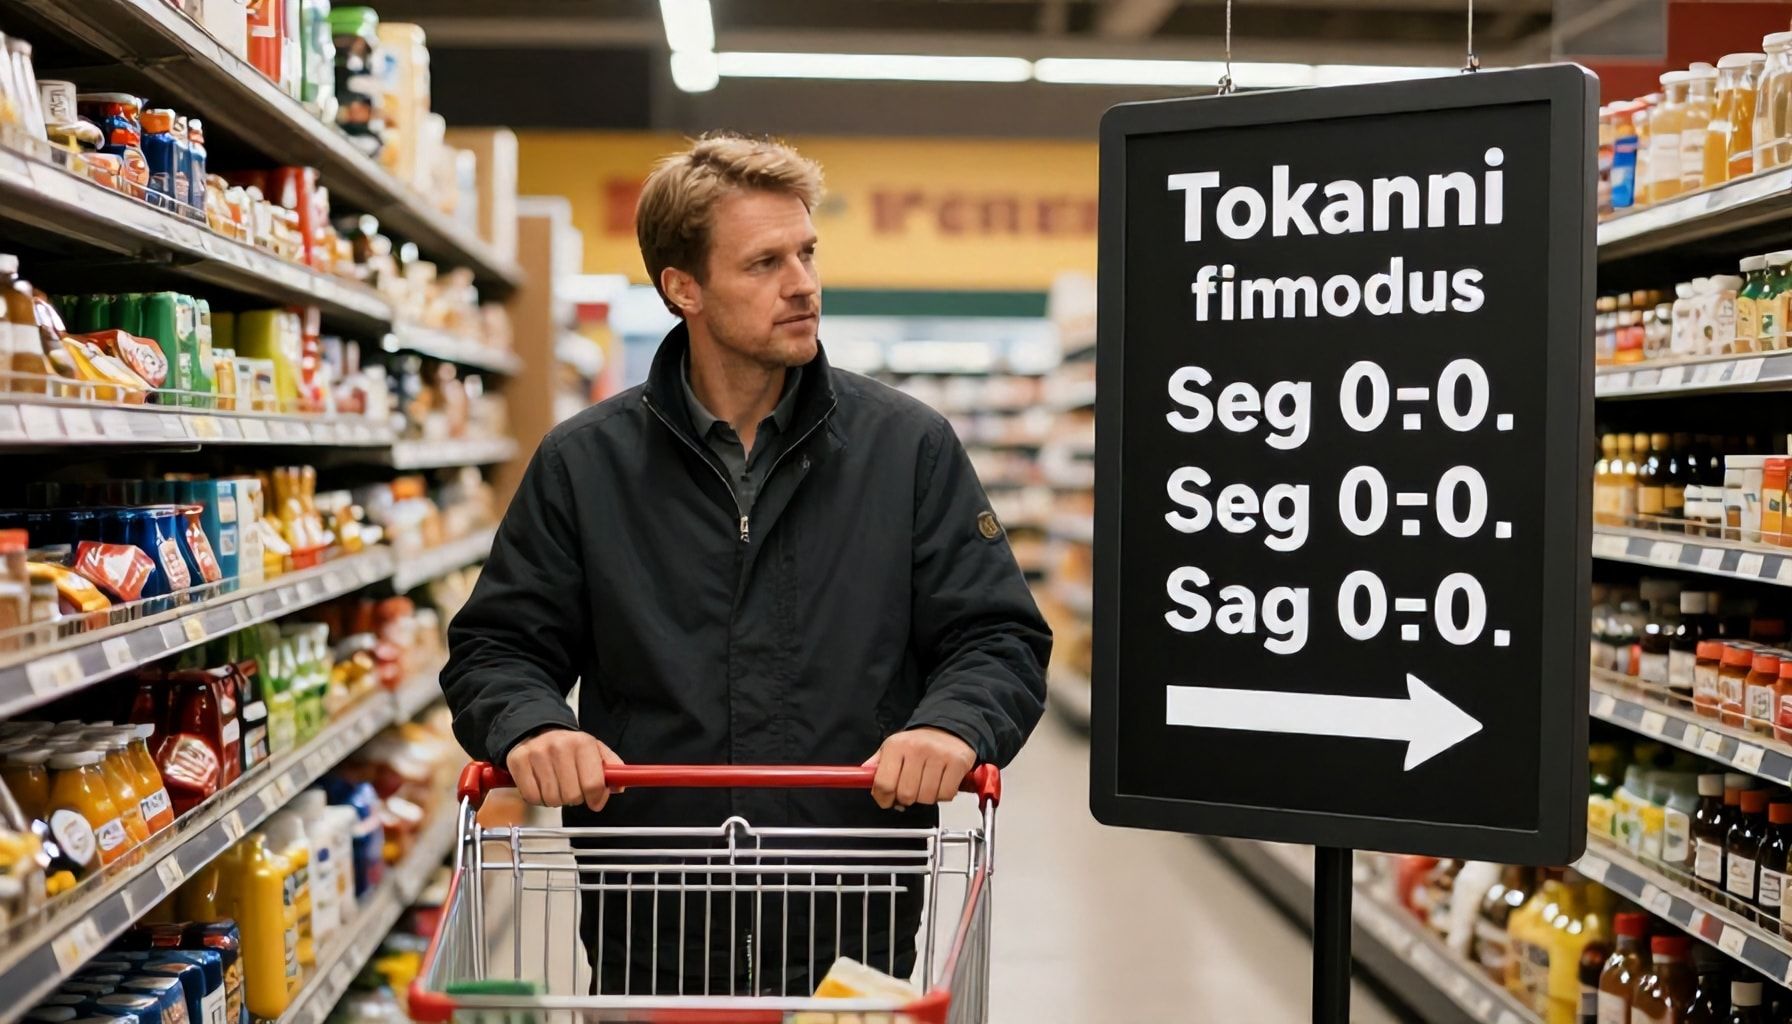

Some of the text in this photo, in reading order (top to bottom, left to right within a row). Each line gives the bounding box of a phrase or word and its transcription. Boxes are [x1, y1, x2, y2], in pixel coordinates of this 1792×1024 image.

[1167, 146, 1505, 243] Tokanni
[1165, 365, 1312, 450] Seg
[1164, 466, 1310, 552] Seg
[1164, 565, 1310, 655] Sag
